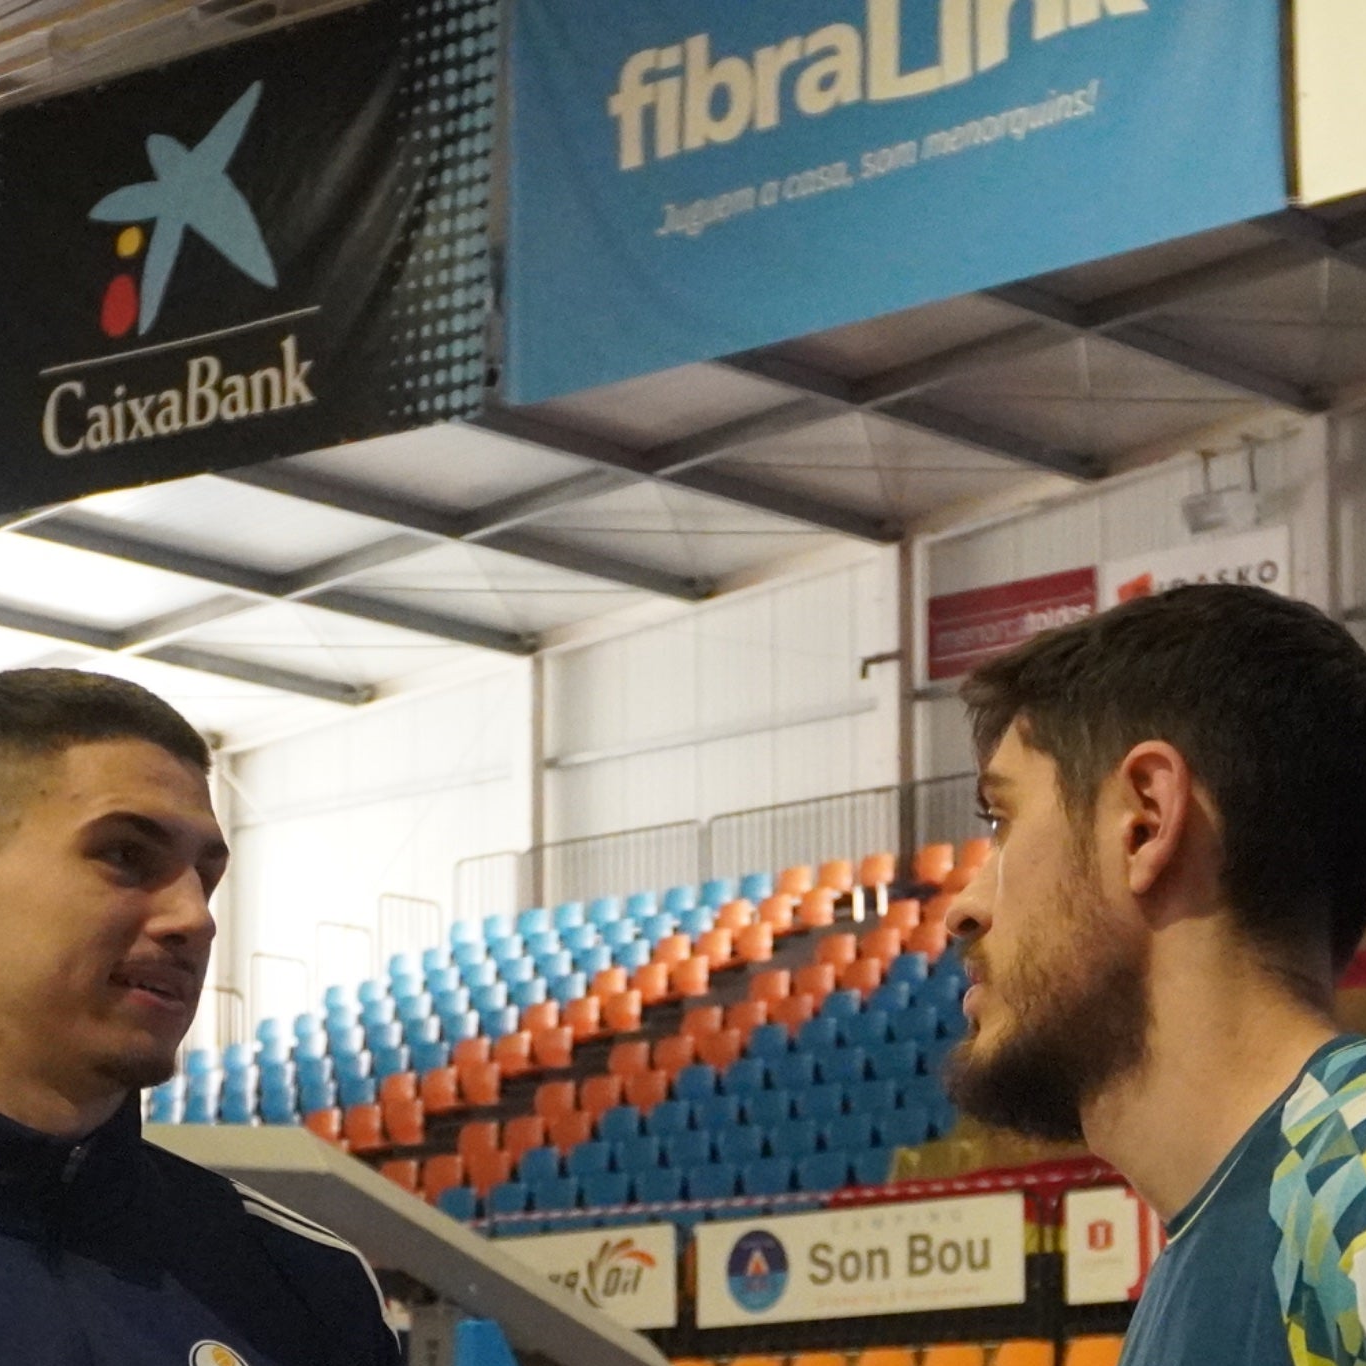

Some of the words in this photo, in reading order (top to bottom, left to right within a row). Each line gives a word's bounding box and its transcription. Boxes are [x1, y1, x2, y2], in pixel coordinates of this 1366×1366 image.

[607, 0, 1149, 170] fibraLin
[860, 140, 917, 179] som
[42, 334, 318, 457] CaixaBank
[809, 1243, 890, 1285] Son
[908, 1234, 991, 1278] Bou
